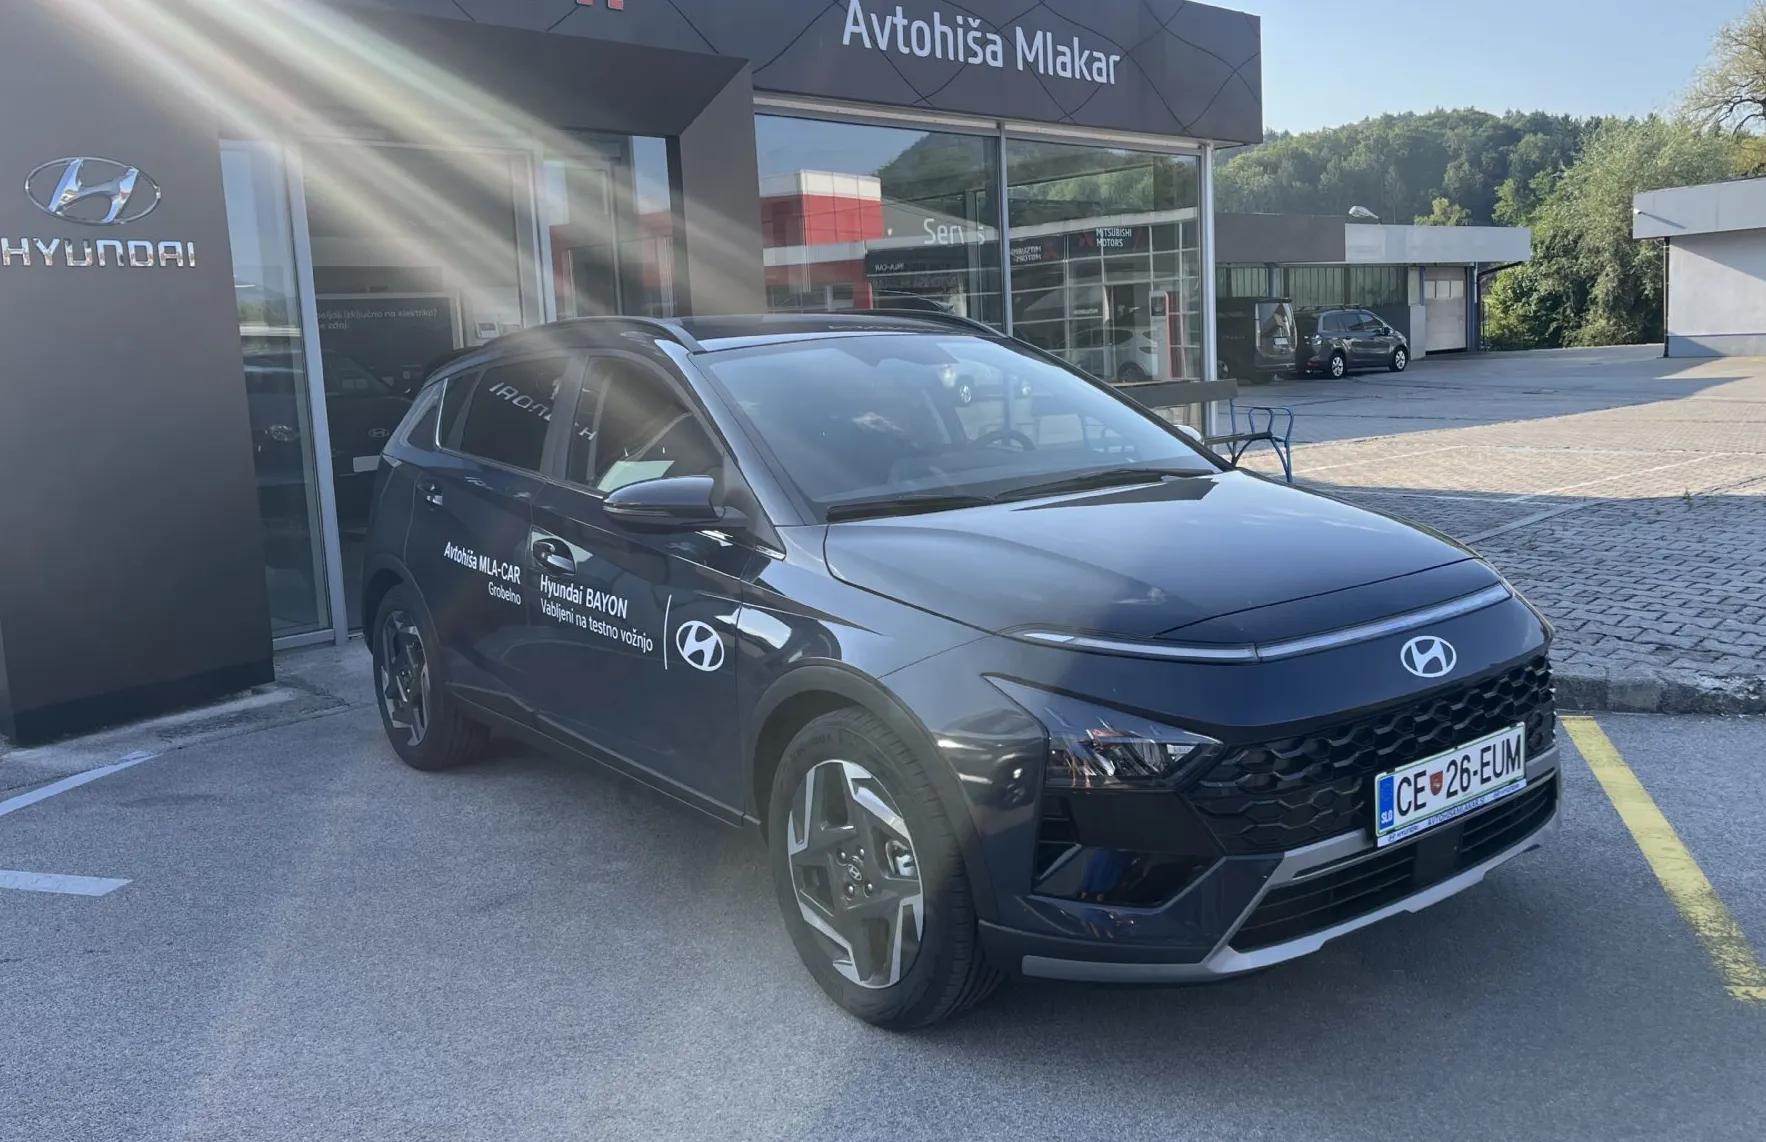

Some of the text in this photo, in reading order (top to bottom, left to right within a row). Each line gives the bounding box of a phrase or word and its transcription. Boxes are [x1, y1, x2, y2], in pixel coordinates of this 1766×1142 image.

[842, 0, 1121, 85] Avtohiša Mlakar
[1095, 227, 1132, 238] MITSUBISHI
[1096, 238, 1124, 248] MOTORS
[0, 236, 197, 268] HYUNDAI
[444, 541, 521, 585] Avtohiša MLA-CAR
[488, 581, 522, 606] Grobelno
[540, 574, 628, 619] Hyundai BAYON
[540, 598, 654, 654] Vabljeni na testno vožnjo
[1397, 734, 1521, 817] CE 26-EUM
[1381, 809, 1394, 825] SLO
